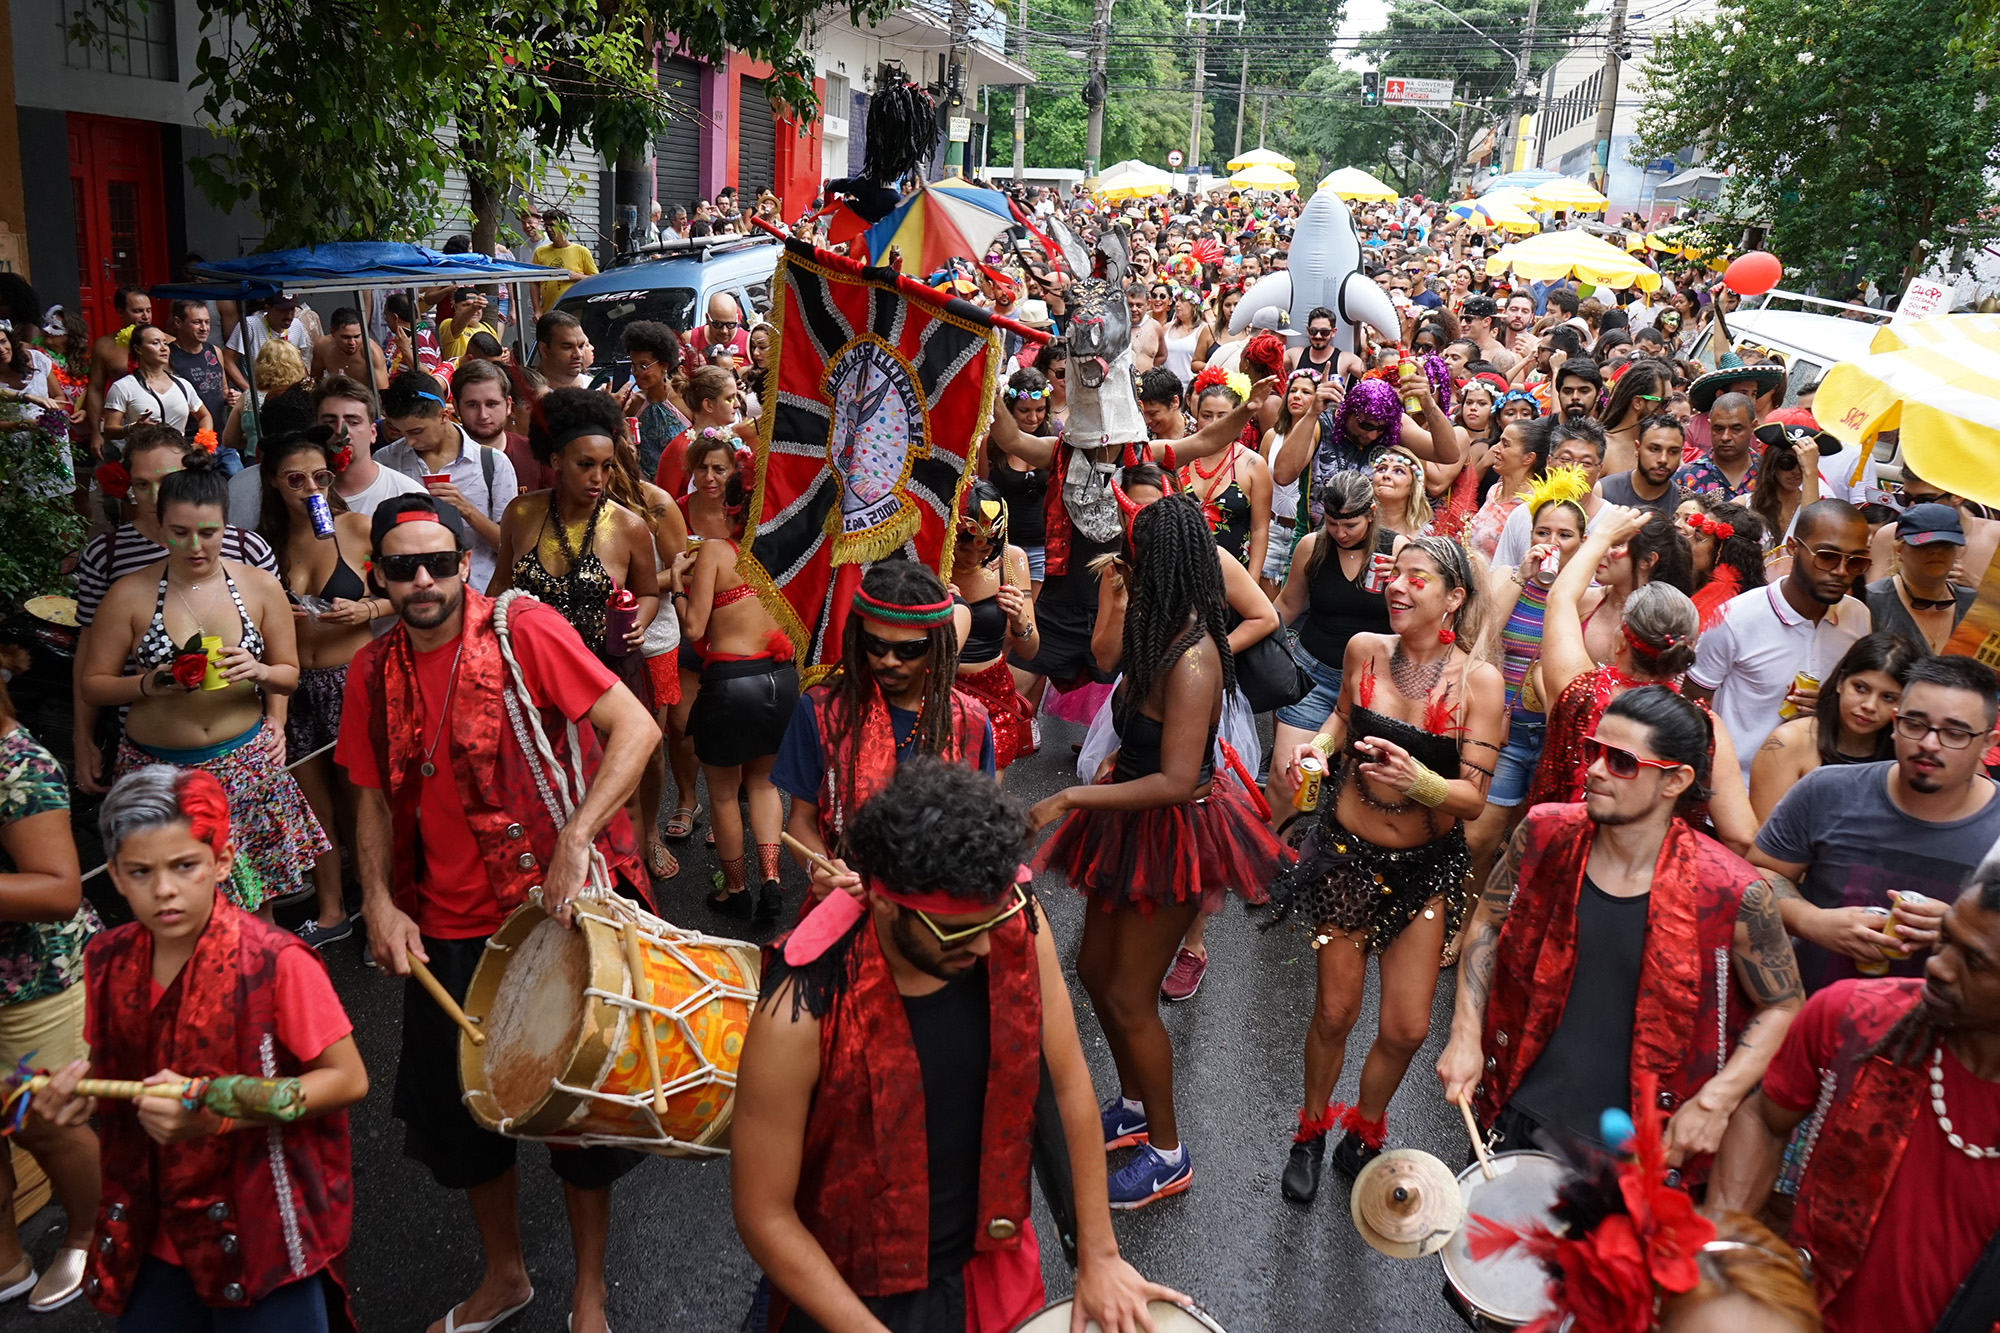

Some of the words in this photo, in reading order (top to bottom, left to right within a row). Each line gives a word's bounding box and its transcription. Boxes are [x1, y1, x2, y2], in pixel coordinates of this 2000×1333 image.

[1596, 276, 1612, 285] SKOL
[1840, 407, 1869, 430] SKOL
[909, 422, 924, 447] SP
[845, 517, 867, 532] EM
[866, 499, 900, 527] 2000
[1306, 778, 1319, 803] SKOL
